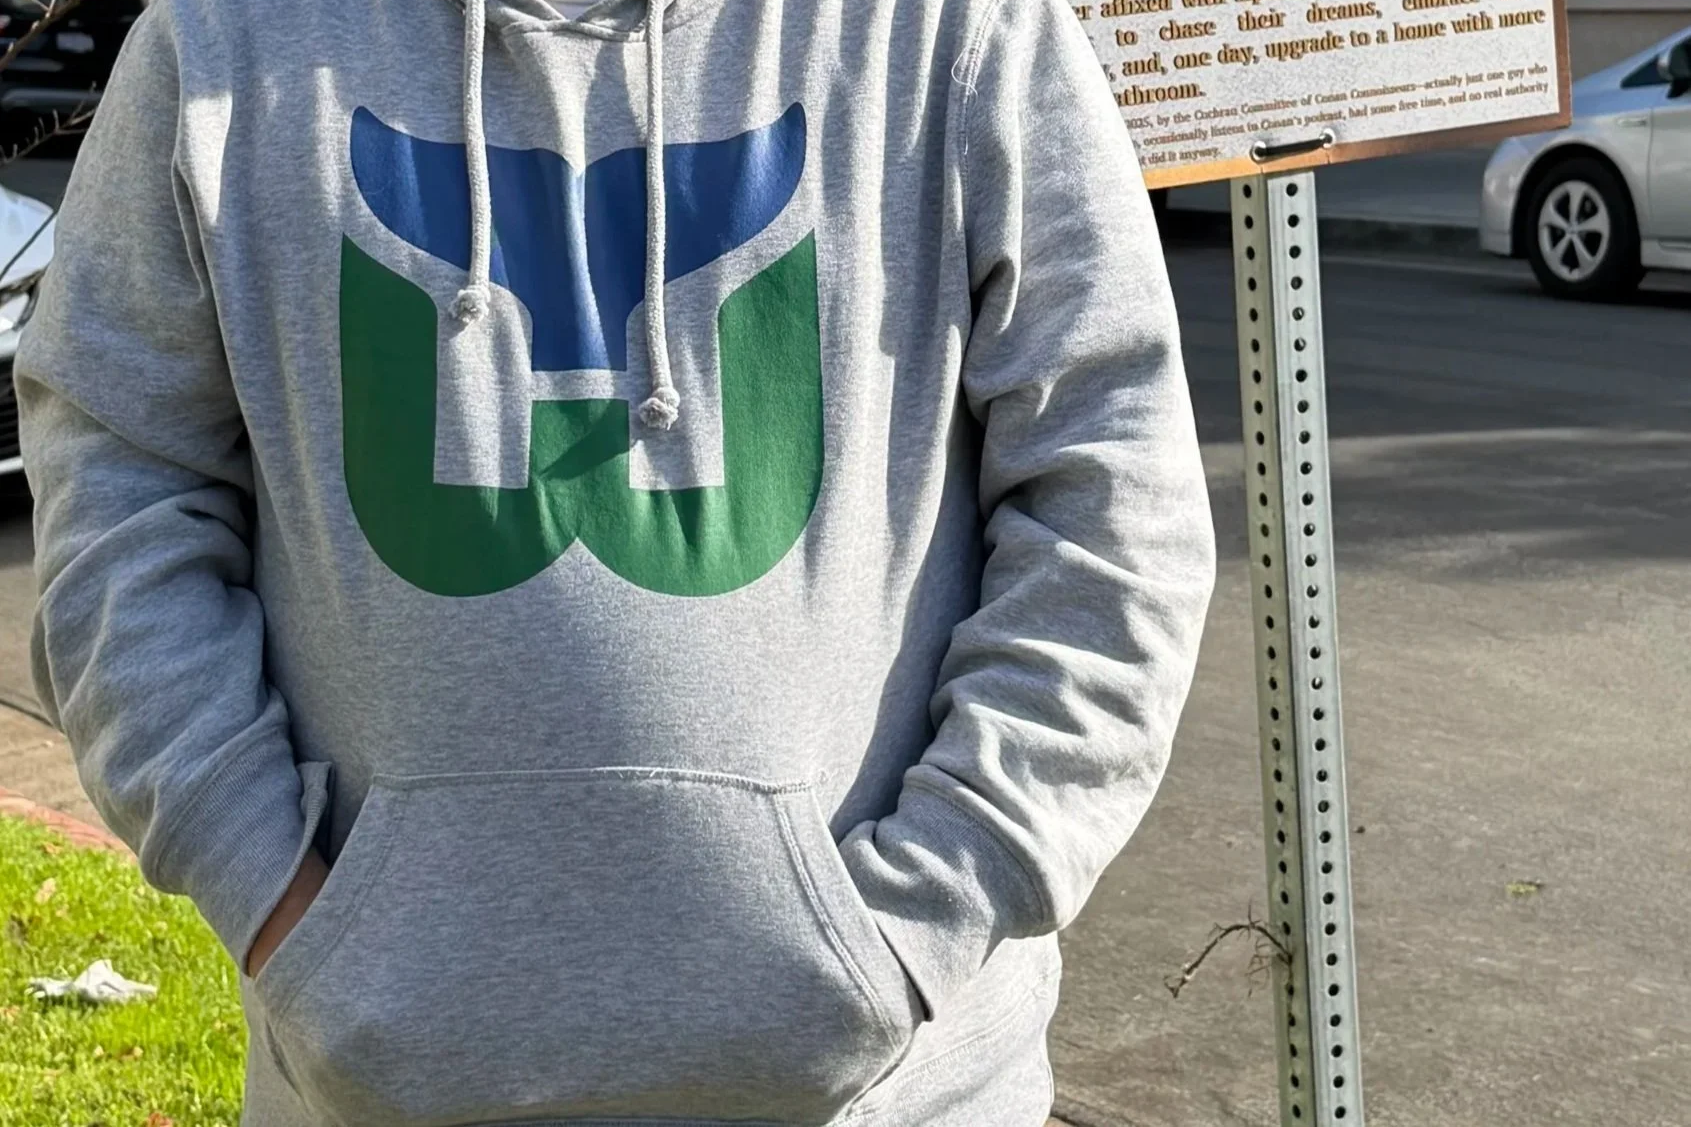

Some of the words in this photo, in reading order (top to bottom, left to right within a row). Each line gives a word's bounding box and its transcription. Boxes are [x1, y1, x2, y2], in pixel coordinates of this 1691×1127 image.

[1114, 28, 1138, 47] to
[1158, 19, 1217, 42] chase
[1236, 8, 1286, 32] their
[1306, 2, 1382, 24] dreams,
[1121, 51, 1167, 77] and,
[1173, 52, 1212, 70] one
[1217, 43, 1259, 66] day,
[1264, 30, 1345, 62] upgrade
[1349, 30, 1371, 47] to
[1375, 29, 1389, 44] a
[1393, 22, 1447, 42] home
[1451, 11, 1493, 34] with
[1498, 10, 1545, 28] more
